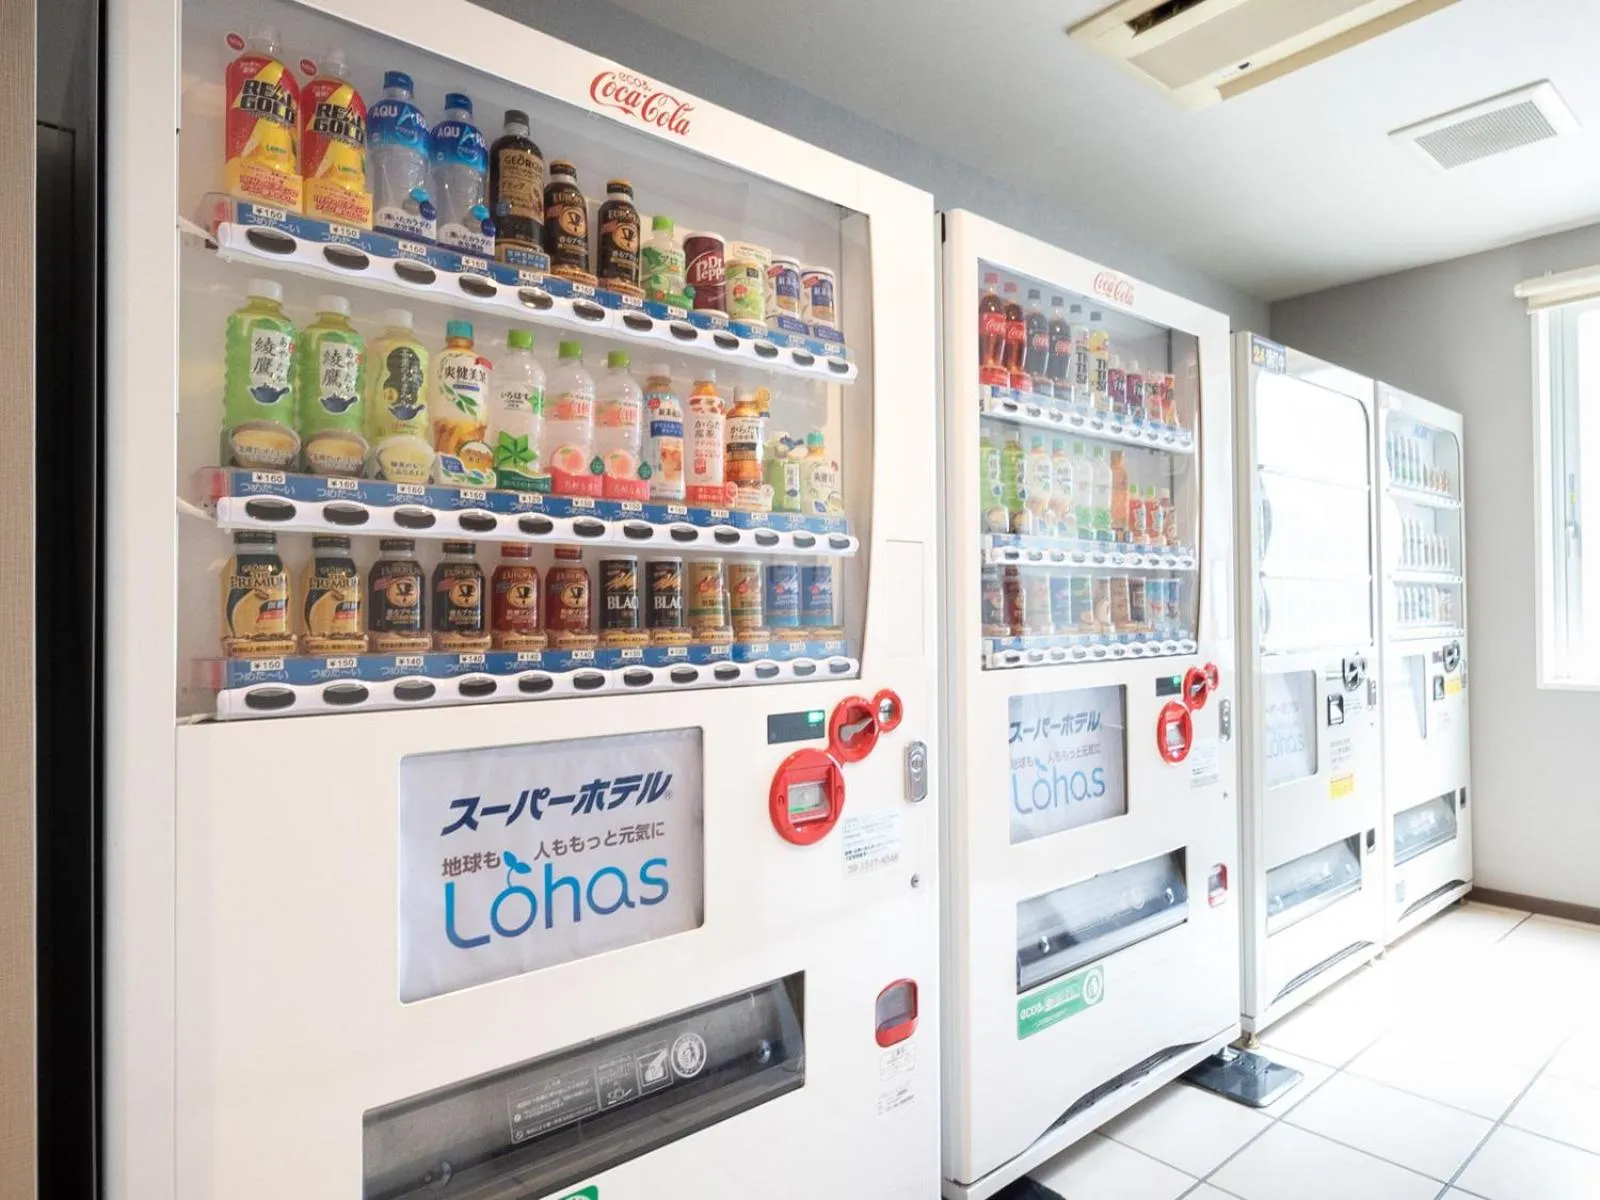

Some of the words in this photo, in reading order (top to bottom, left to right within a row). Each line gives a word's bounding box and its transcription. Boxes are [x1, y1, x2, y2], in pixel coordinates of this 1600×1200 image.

[240, 94, 295, 124] GOLD
[589, 71, 695, 136] Coca-Cola
[313, 116, 364, 145] GOLD
[253, 337, 276, 379] 綾鷹
[321, 348, 343, 389] 綾鷹
[1008, 712, 1102, 745] スーパーホテル
[440, 770, 673, 837] スーパーホテル
[1012, 765, 1106, 816] Lohas
[441, 851, 501, 878] 地球も
[533, 821, 665, 861] 人ももっと元気に
[445, 855, 669, 949] Lohas
